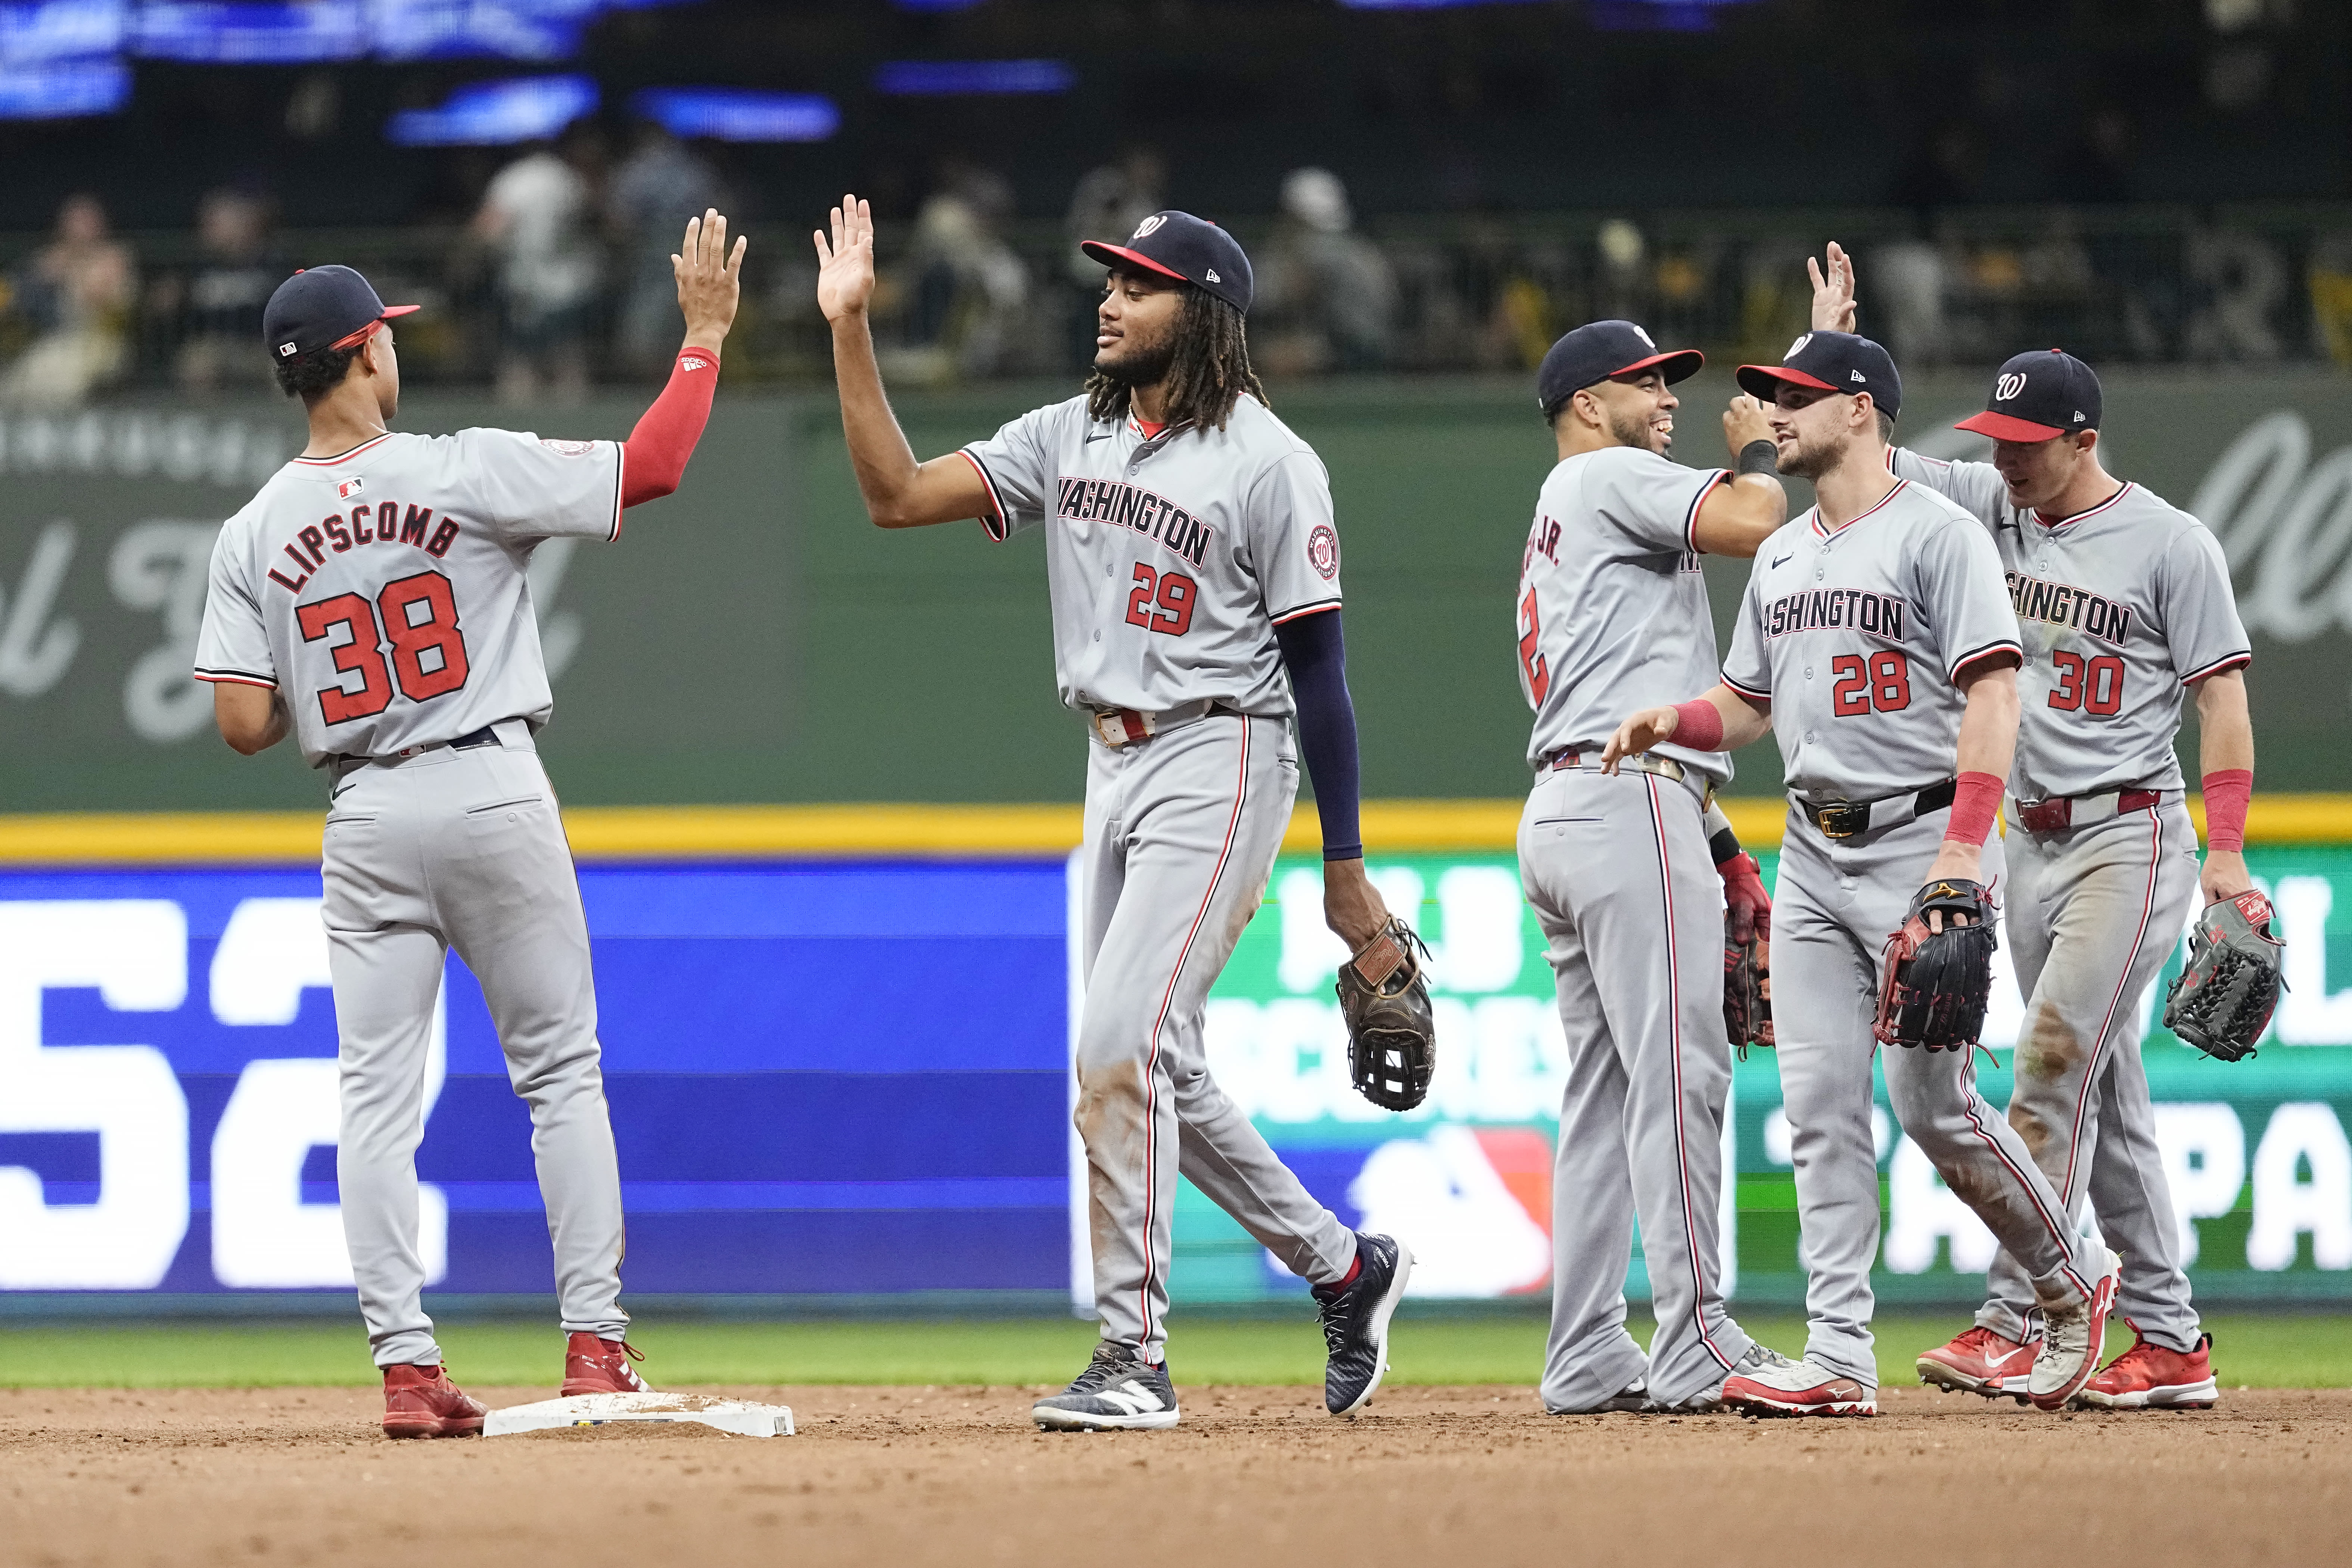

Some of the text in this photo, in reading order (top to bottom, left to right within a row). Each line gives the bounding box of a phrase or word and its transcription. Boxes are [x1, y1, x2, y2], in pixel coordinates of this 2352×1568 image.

[681, 357, 707, 367] adidas
[1996, 373, 2027, 401] W
[268, 501, 460, 595] LIPSCOMB
[1310, 528, 1334, 548] WASHINGTON
[1314, 560, 1335, 577] NATIONALS
[1125, 561, 1198, 637] 29
[1762, 588, 1905, 645] ASHINGTON
[295, 570, 470, 727] 38
[1832, 649, 1911, 718] 28
[2047, 649, 2125, 716] 30
